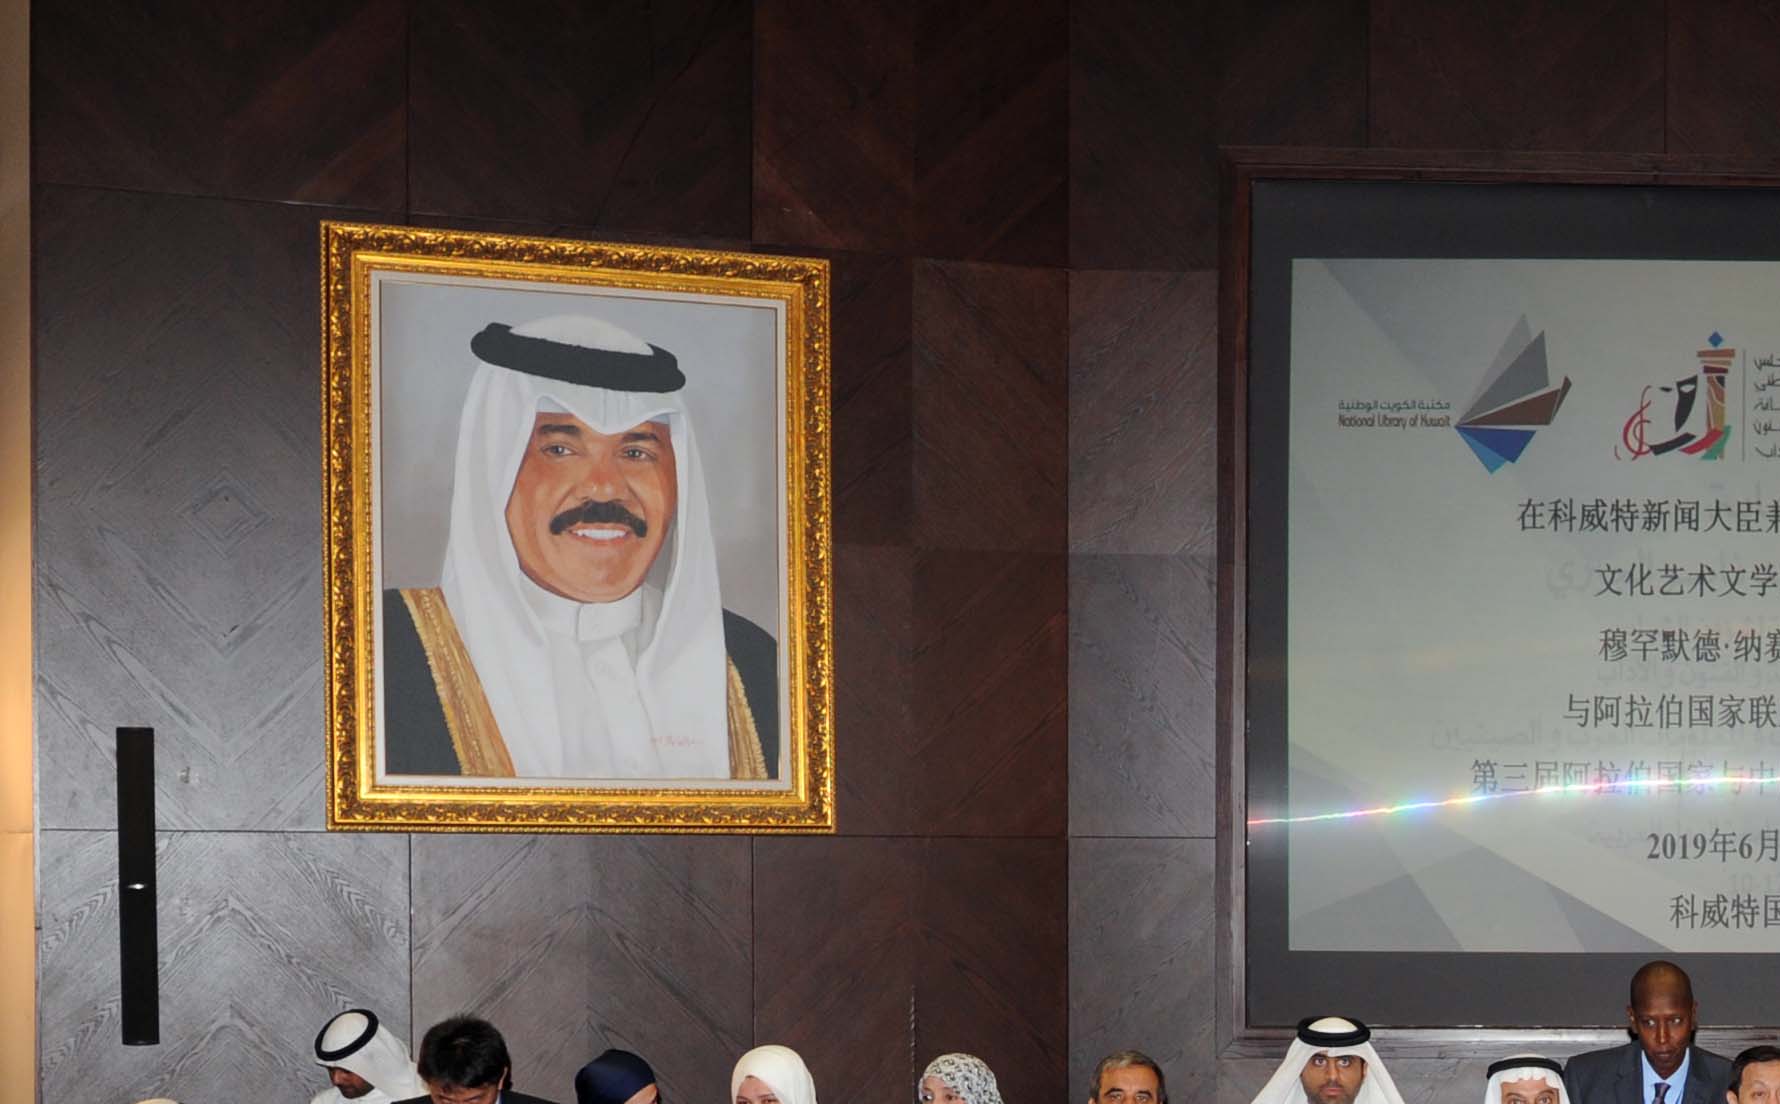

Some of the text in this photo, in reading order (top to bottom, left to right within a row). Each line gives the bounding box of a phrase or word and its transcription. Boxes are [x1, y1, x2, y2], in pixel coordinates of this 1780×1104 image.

[1338, 413, 1376, 427] National
[1378, 412, 1407, 431] Library
[1420, 413, 1451, 427] Kuwait
